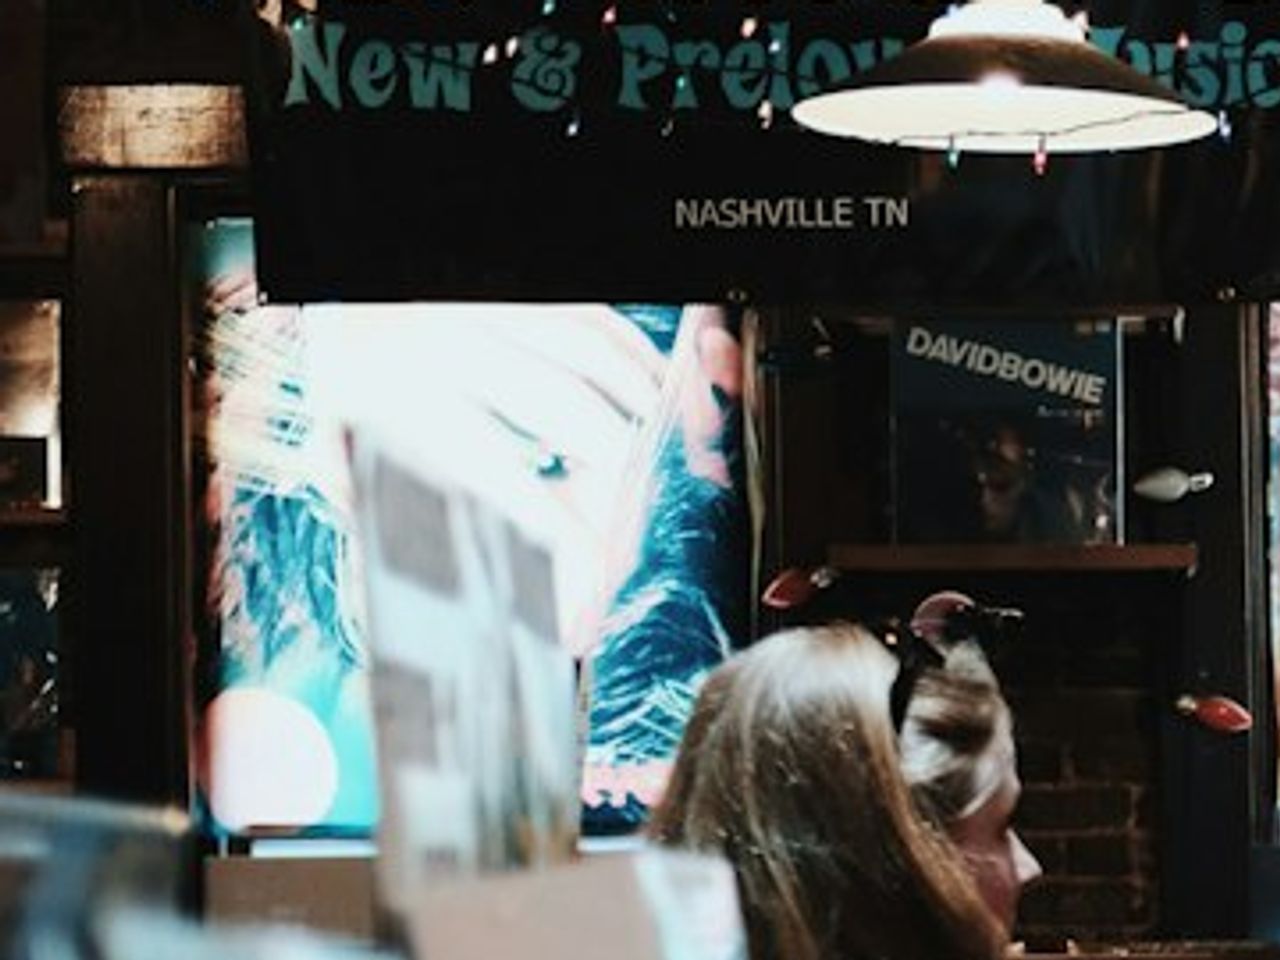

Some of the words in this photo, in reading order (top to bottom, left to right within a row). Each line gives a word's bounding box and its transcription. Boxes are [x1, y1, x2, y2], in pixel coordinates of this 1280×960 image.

[284, 23, 478, 113] New
[511, 27, 582, 113] &
[674, 197, 854, 228] NASHVILLE
[862, 197, 909, 228] TN
